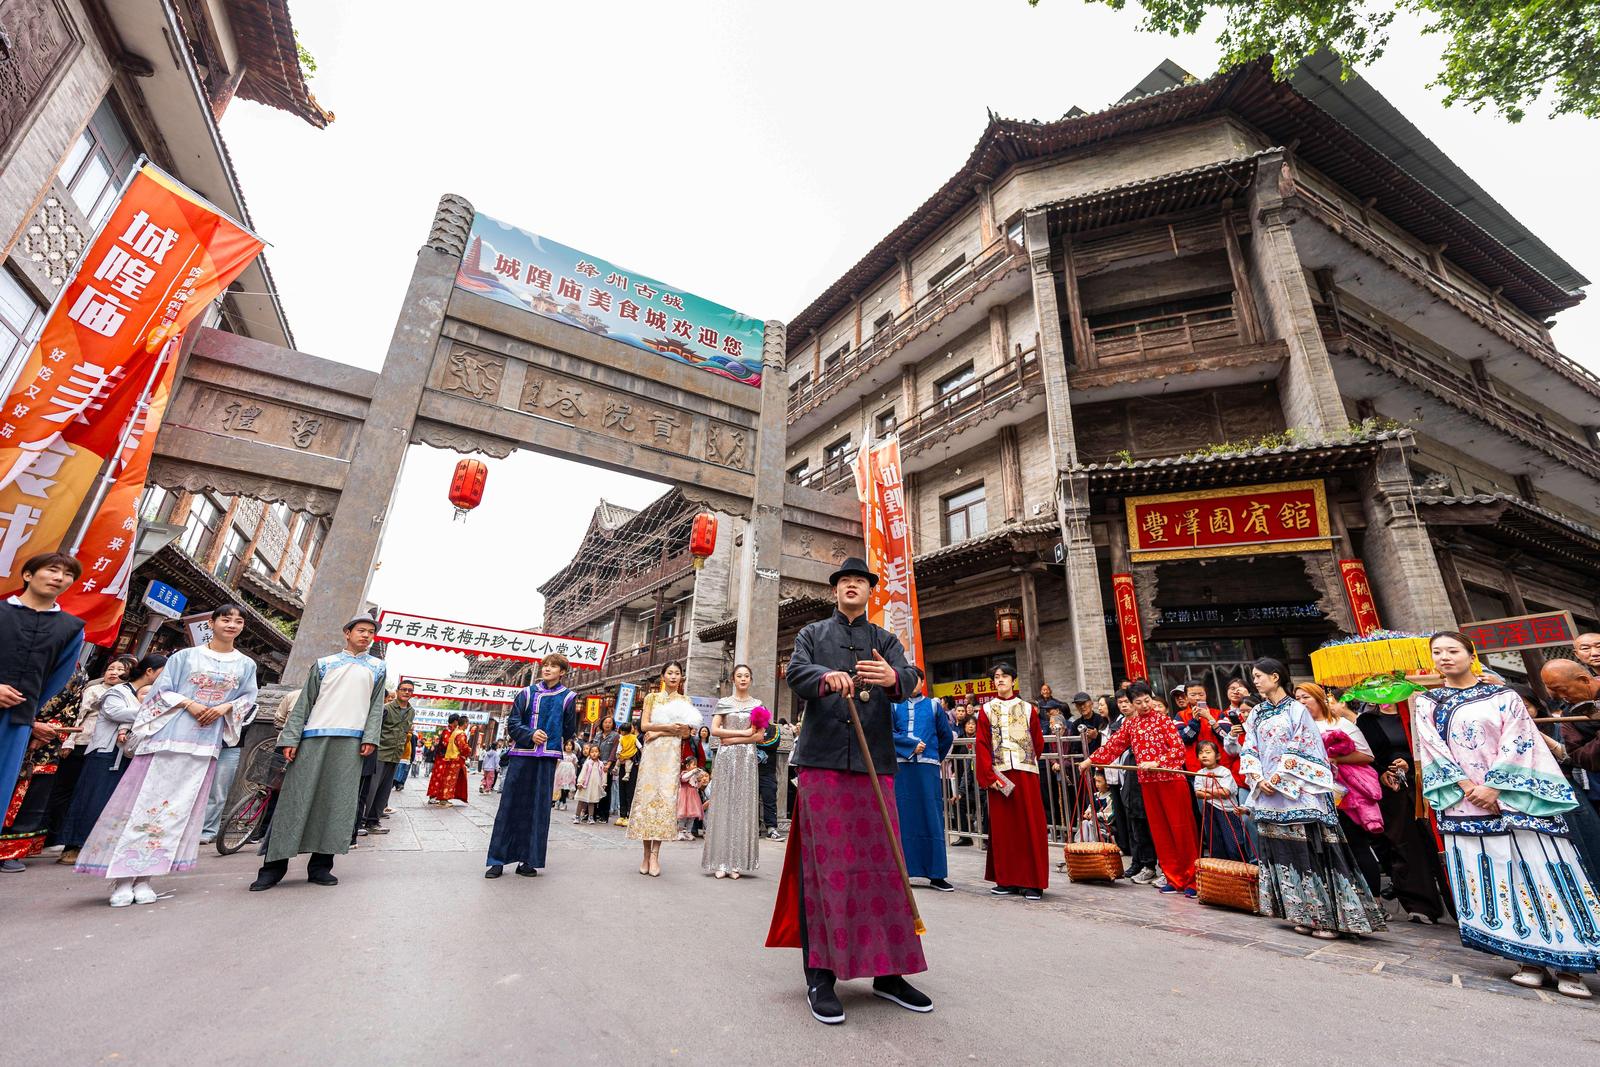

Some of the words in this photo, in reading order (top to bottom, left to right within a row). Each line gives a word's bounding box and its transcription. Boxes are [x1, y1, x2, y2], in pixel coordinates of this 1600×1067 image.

[68, 209, 179, 339] 城隍庙
[493, 253, 743, 357] 城隍庙美食城欢迎您
[575, 260, 685, 312] 绛州古城
[0, 347, 67, 439] 好吃又好玩
[1469, 616, 1565, 648] 丰泽园
